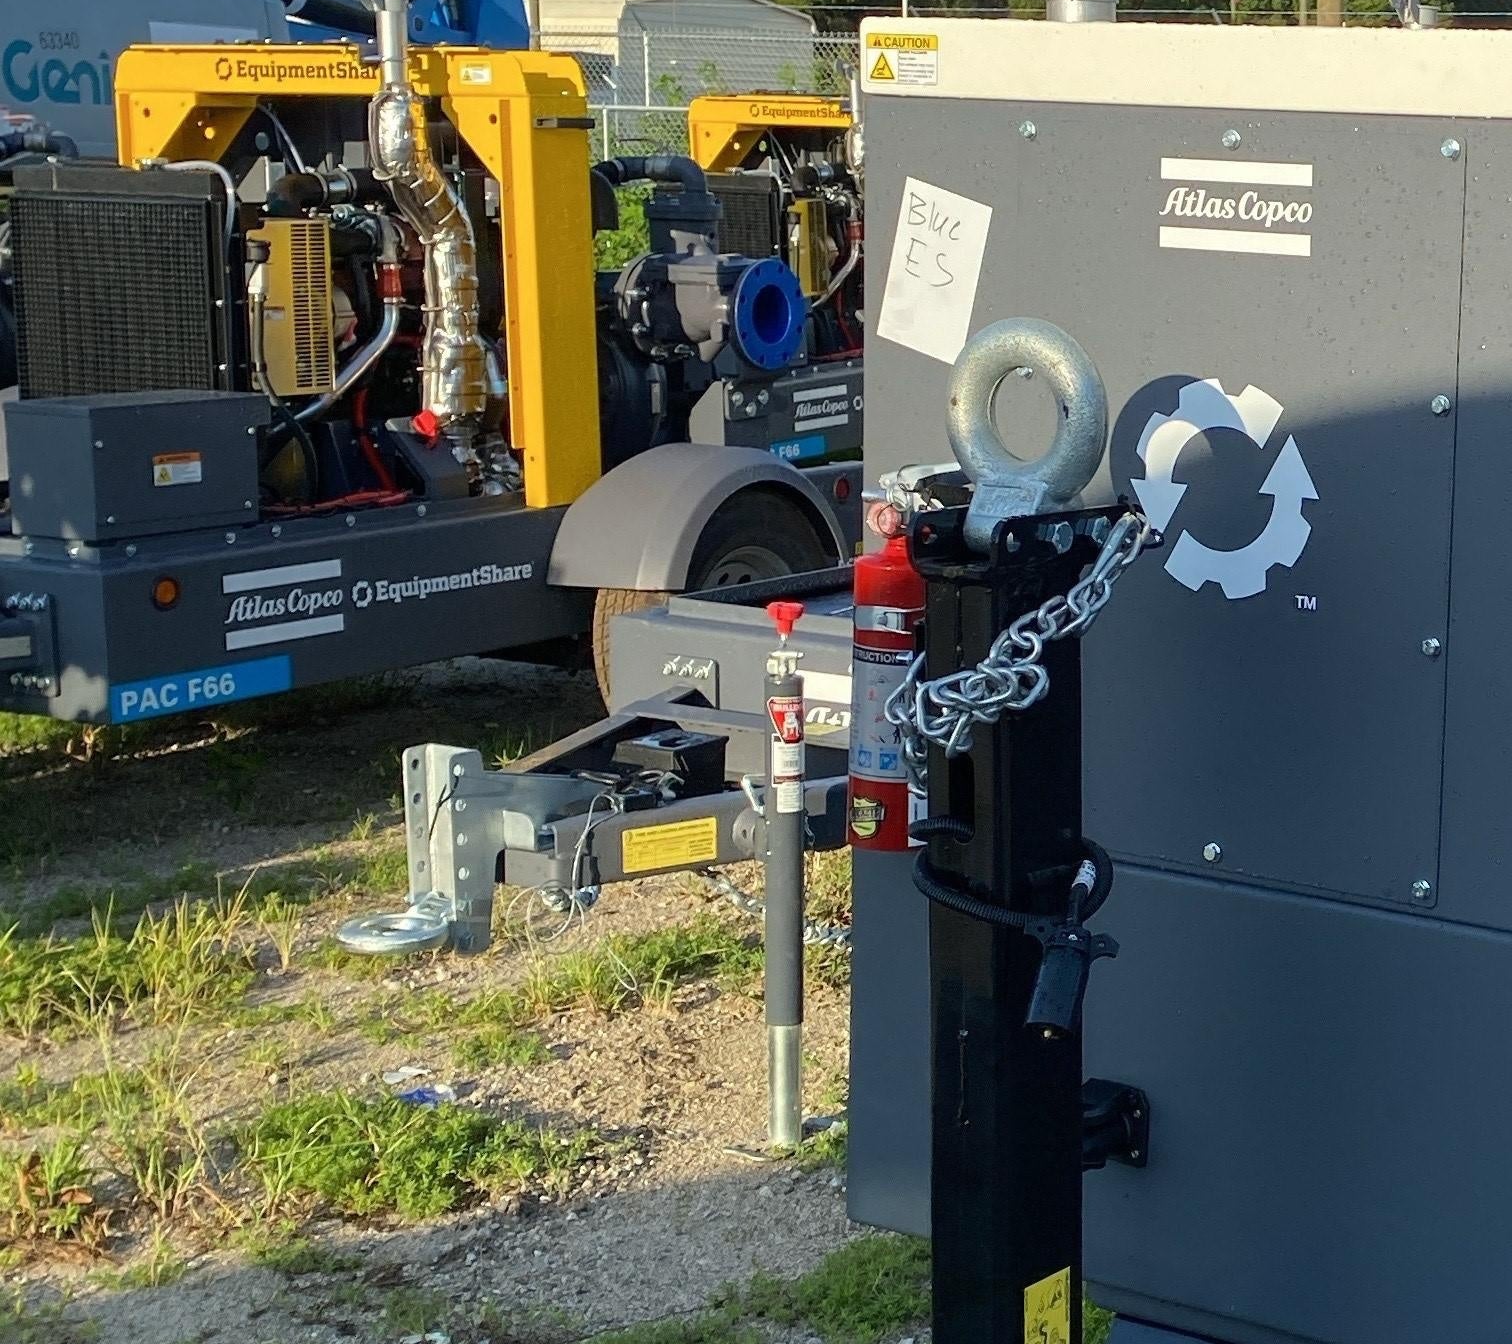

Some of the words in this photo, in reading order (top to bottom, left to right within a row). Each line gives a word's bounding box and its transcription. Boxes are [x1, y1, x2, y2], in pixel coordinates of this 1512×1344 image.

[884, 37, 930, 48] CAUTION
[3, 39, 112, 105] Geni
[236, 60, 379, 82] EquipmentShar
[907, 191, 961, 241] Blue
[1158, 187, 1237, 219] Atlas
[1238, 190, 1313, 228] Copco
[376, 563, 532, 602] EquipmentShare
[225, 594, 285, 624] Atlas
[286, 588, 344, 617] Copco
[1294, 595, 1317, 611] TM
[121, 683, 179, 716] PAC
[188, 673, 236, 703] F66
